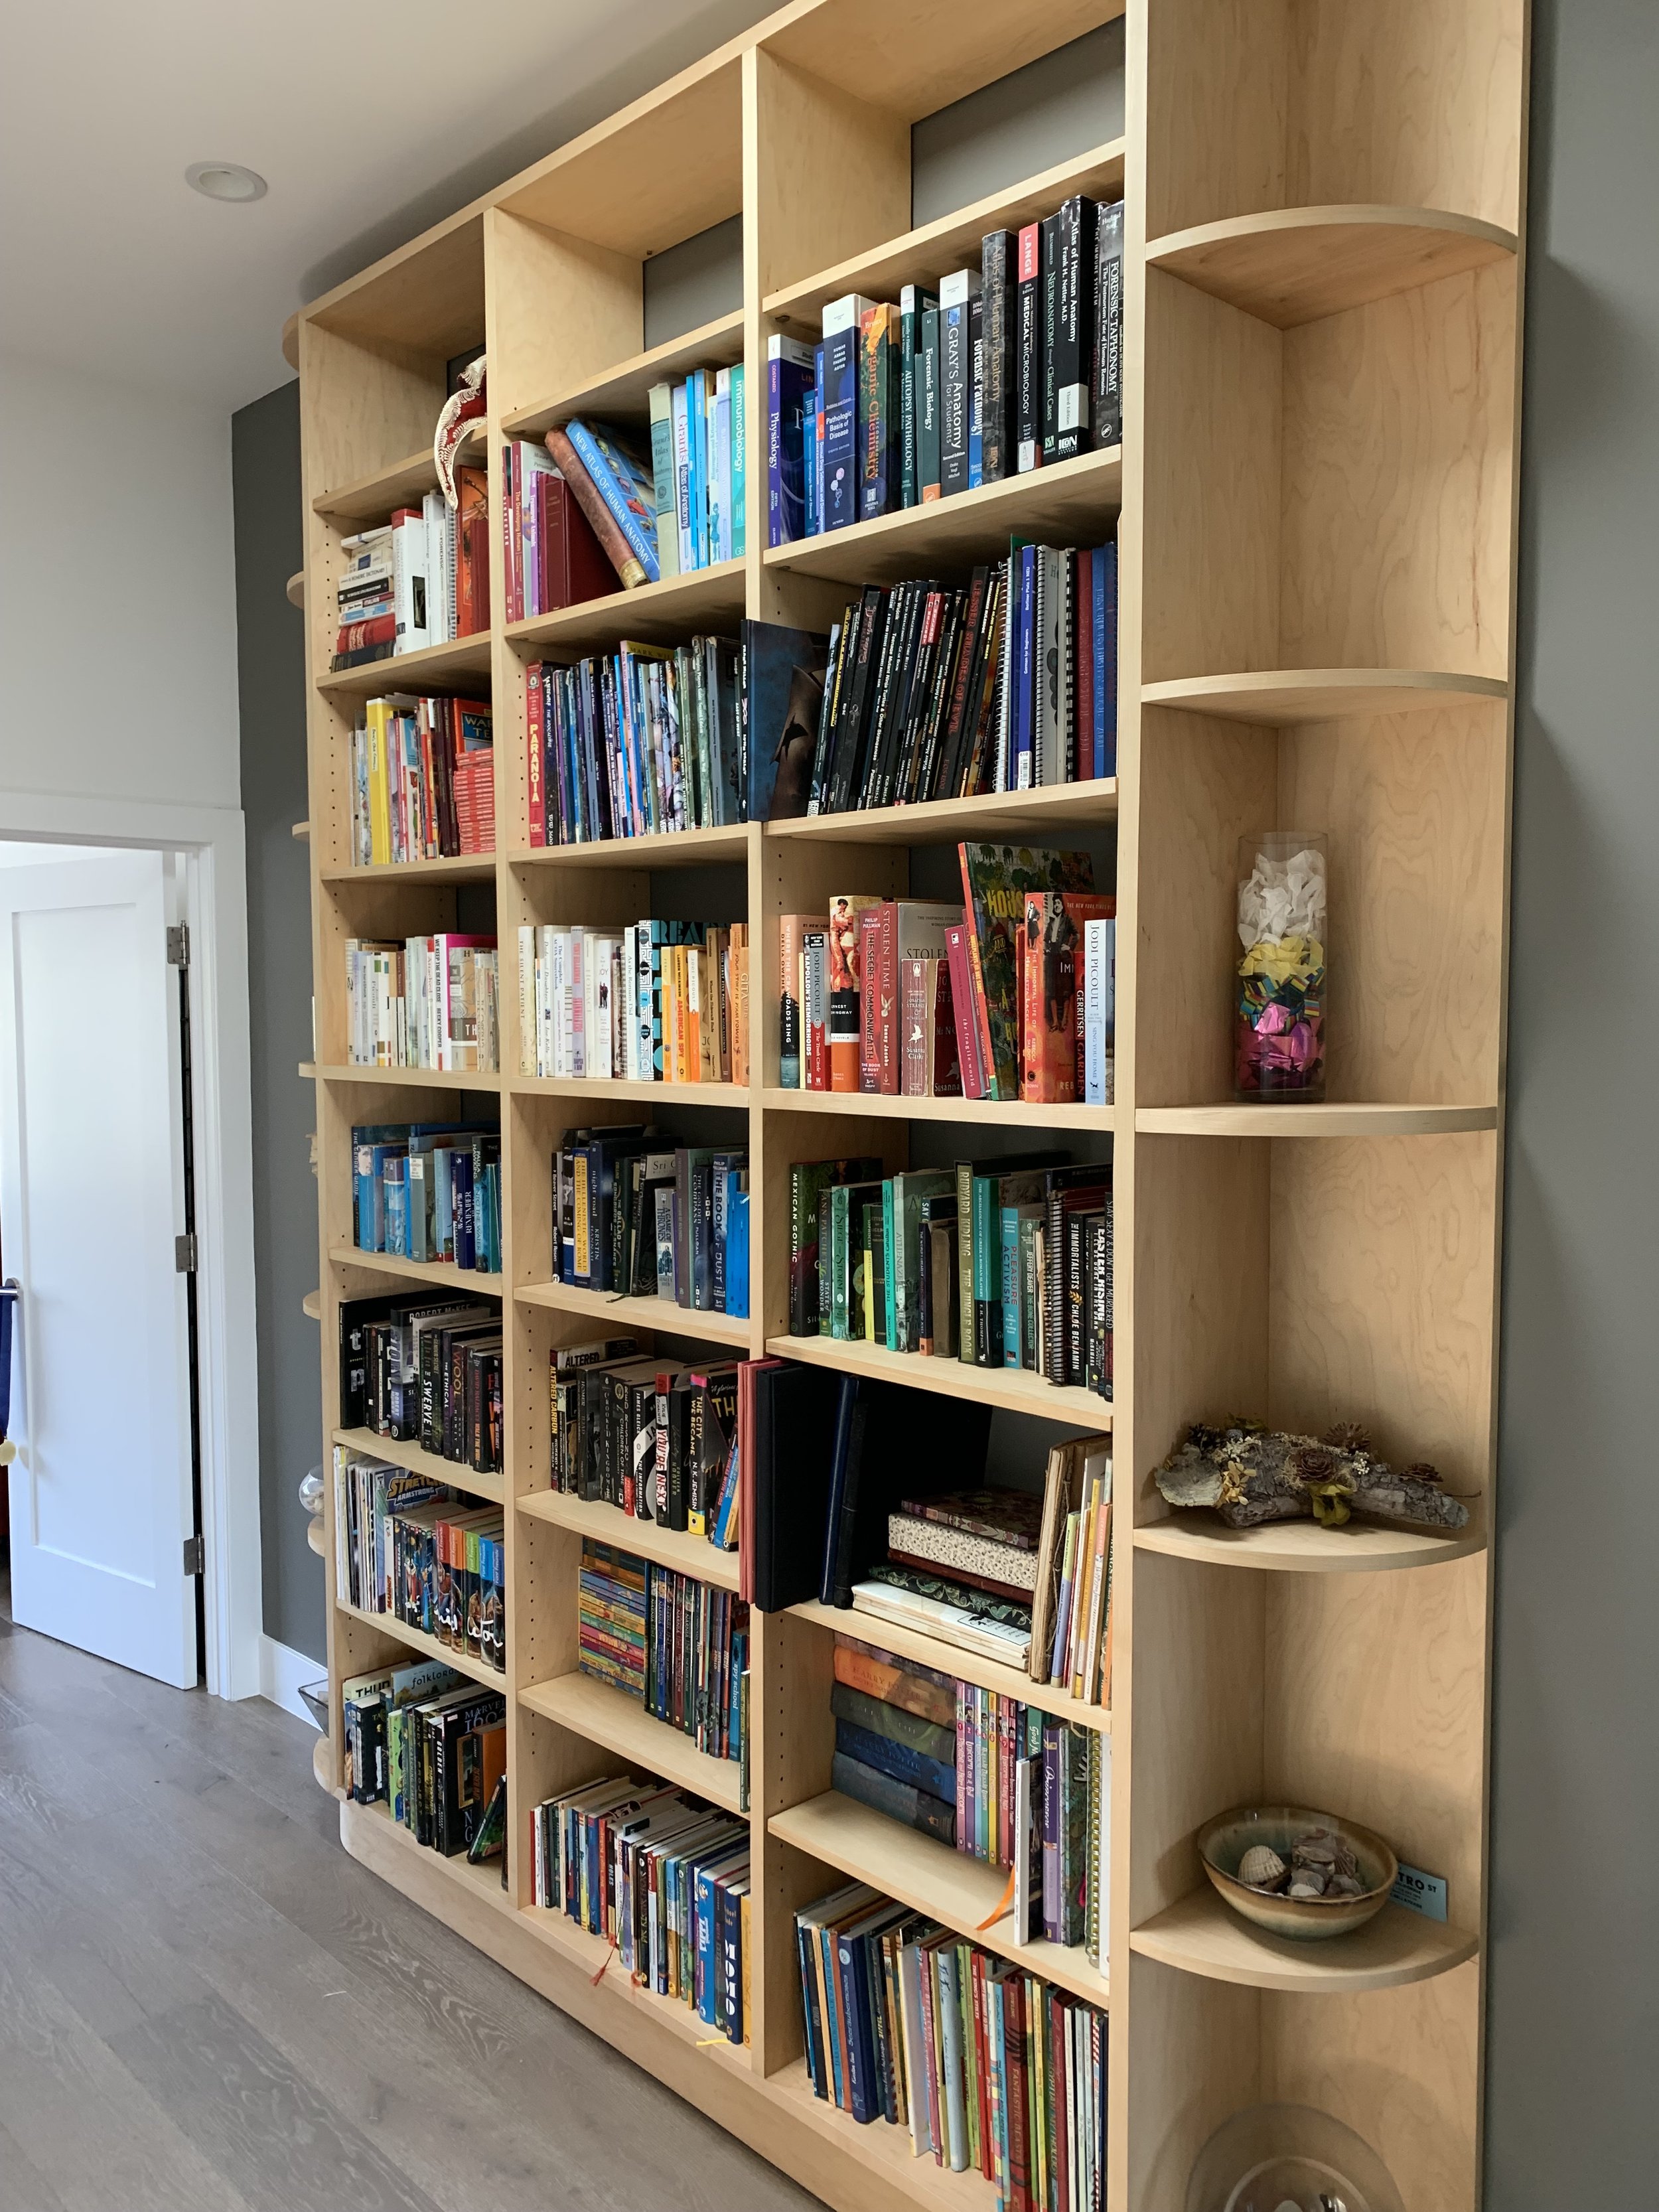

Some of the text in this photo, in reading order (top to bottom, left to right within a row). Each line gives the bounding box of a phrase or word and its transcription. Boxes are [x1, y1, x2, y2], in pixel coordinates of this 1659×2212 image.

[1024, 234, 1032, 273] LANGE
[1068, 220, 1079, 342] Atlas of Human Anatomy
[1108, 261, 1120, 392] FORENSIC TAPHONOMY
[948, 327, 963, 449] GRAY'S Anatomy
[826, 411, 852, 425] Pathologic
[829, 421, 849, 432] Basis of
[924, 391, 934, 431] Biology
[769, 412, 779, 470] Physiology
[829, 429, 849, 440] Disease
[680, 466, 689, 484] Atlas
[574, 431, 650, 564] NEW ATLAS OF HUMAN ANATOMY
[681, 494, 690, 527] Anatomy
[949, 580, 982, 734] LESSER SHADES OF EVIL
[530, 723, 540, 803] PARANOIA
[873, 729, 882, 761] Strangeness
[1090, 925, 1100, 1010] JODI PICOULT
[865, 984, 874, 1060] COMMONWEALTH
[968, 1064, 976, 1086] world
[959, 1172, 970, 1214] RUDYARD
[960, 1218, 971, 1256] KIPLING
[962, 1269, 971, 1287] THE
[1070, 1230, 1079, 1290] IMMORTALISTS
[963, 1328, 972, 1355] BOOK
[453, 1351, 462, 1397] WOOL
[691, 1400, 696, 1413] WE
[657, 1430, 668, 1506] YOU'RE NEXT
[725, 1939, 737, 2016] MOMO
